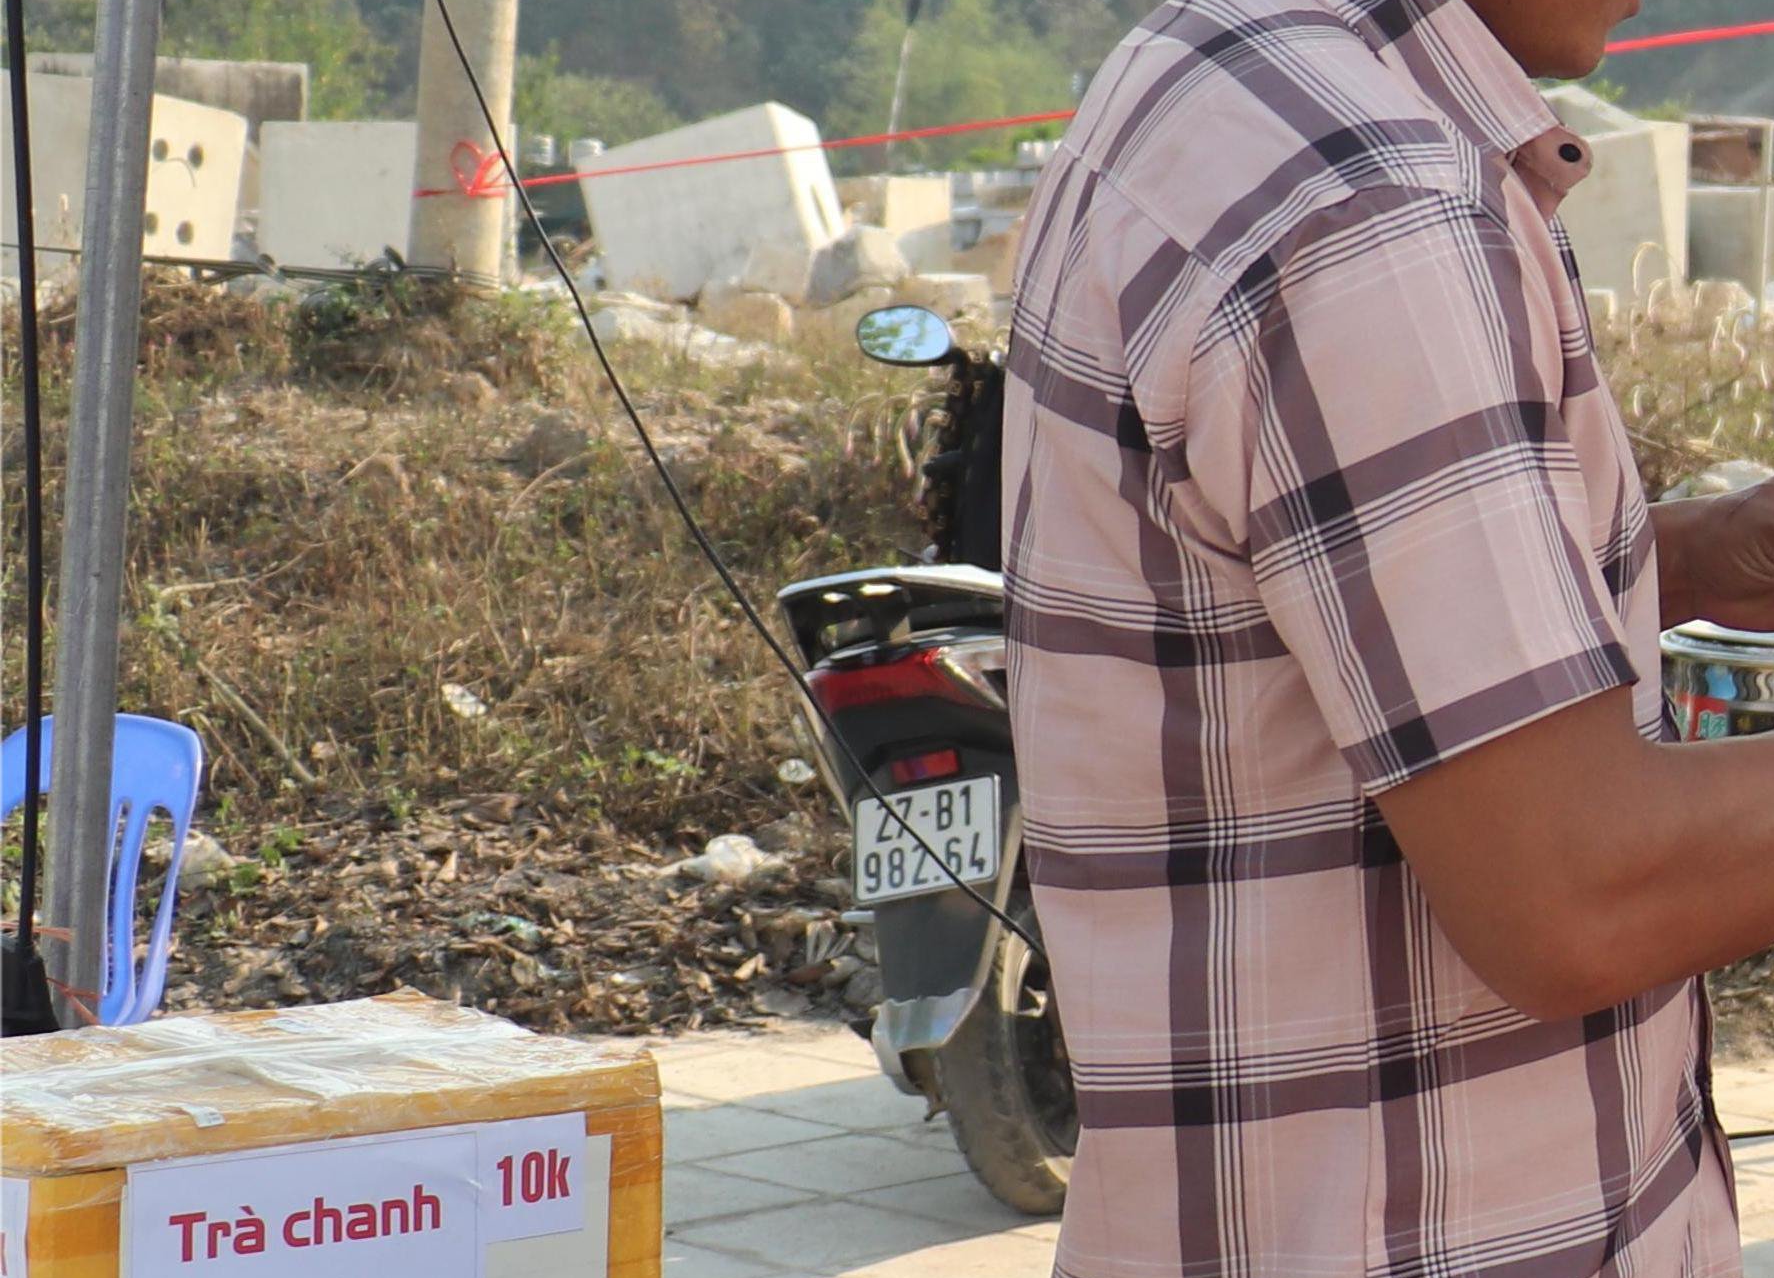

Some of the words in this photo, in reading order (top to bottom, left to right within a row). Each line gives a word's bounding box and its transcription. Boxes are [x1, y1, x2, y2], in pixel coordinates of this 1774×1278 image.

[875, 784, 972, 844] 27-B1
[170, 1204, 266, 1262] Trà
[283, 1185, 441, 1247] chanh
[497, 1150, 570, 1206] 10k
